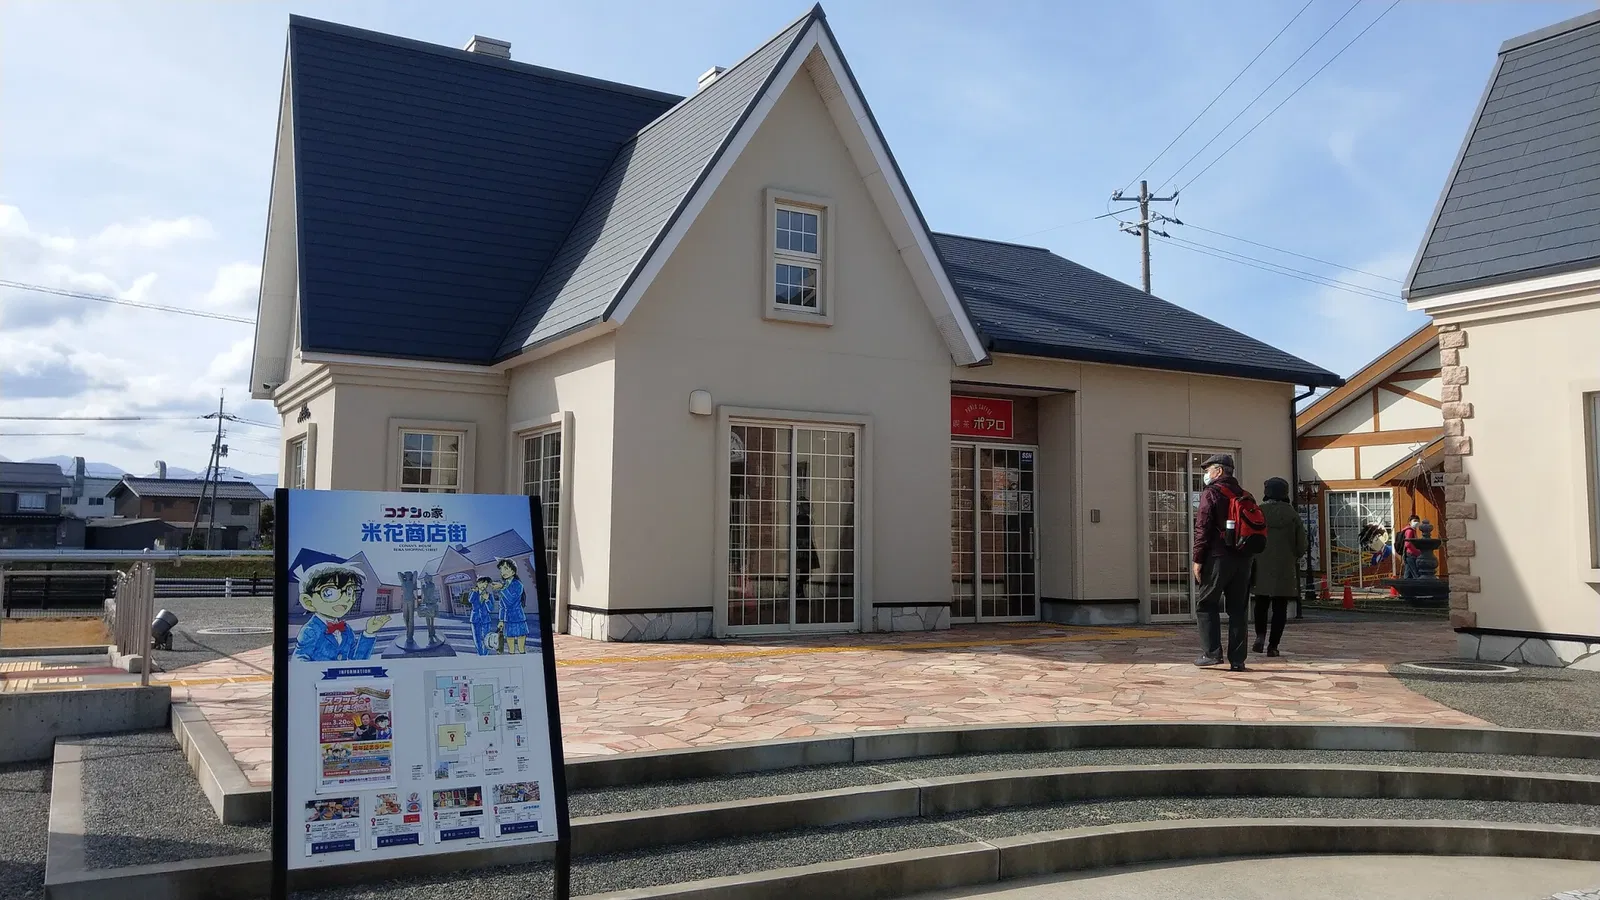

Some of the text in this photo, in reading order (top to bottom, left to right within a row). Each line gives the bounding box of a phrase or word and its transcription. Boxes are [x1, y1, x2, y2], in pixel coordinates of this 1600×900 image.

[973, 416, 1006, 431] ポアロ
[361, 522, 467, 543] 米花商店街
